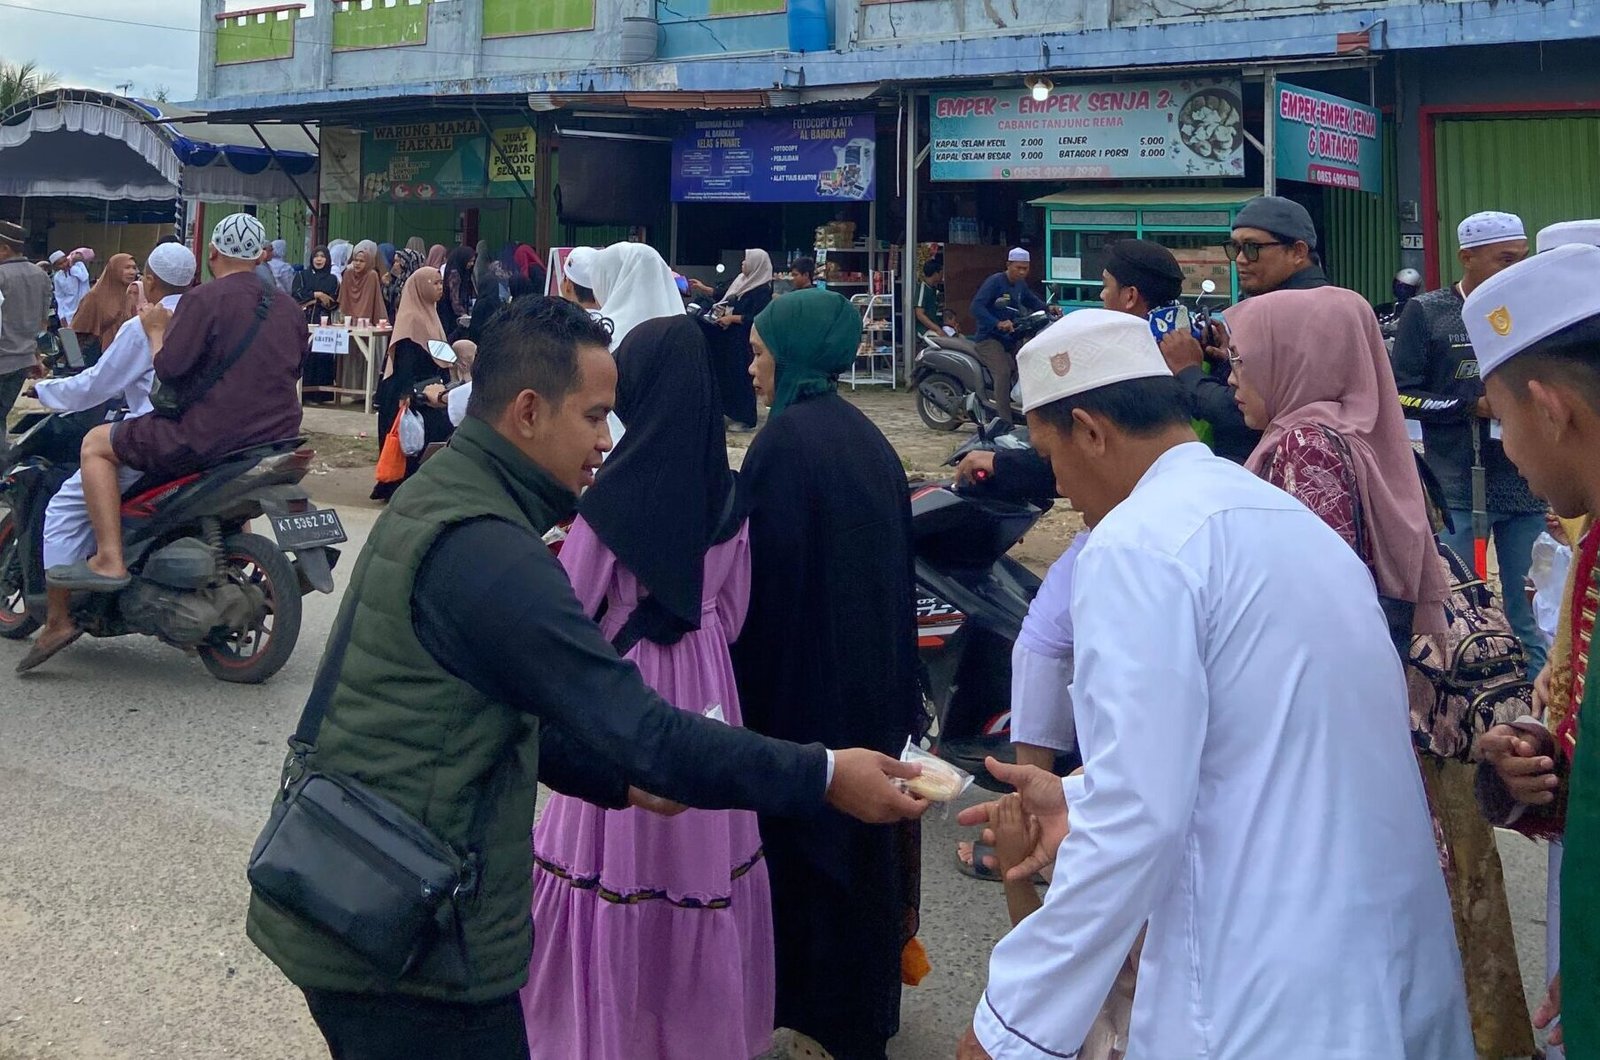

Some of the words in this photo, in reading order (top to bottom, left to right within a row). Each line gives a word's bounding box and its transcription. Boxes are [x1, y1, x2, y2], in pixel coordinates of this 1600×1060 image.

[936, 97, 998, 118] EMPEK
[1018, 93, 1082, 115] EMPEK
[1087, 90, 1150, 112] SENJA
[1156, 89, 1170, 109] 2
[793, 118, 830, 129] FOTOCOPY
[839, 116, 854, 127] ATK
[998, 119, 1040, 130] CABANG
[1042, 118, 1090, 129] TANJUNG
[1093, 116, 1124, 127] REMA
[1352, 109, 1376, 140] SENJA
[375, 124, 431, 139] WARUNG
[435, 120, 478, 135] MAMA
[799, 130, 809, 140] AL
[398, 139, 452, 152] HAEKAL
[935, 139, 959, 148] KAPAL
[961, 138, 985, 148] SELAM
[986, 138, 1007, 148] KECIL
[1020, 138, 1044, 147] 2.000
[1058, 136, 1088, 145] LENJER
[1140, 136, 1165, 145] 5.000
[1309, 128, 1318, 156] &
[1319, 131, 1360, 164] BATAGOR
[494, 153, 535, 165] POTONG
[935, 152, 959, 161] KAPAL
[961, 152, 986, 161] SELAM
[987, 152, 1012, 161] BESAR
[1020, 151, 1044, 160] 9.000
[1058, 149, 1097, 159] BATAGOR
[1104, 148, 1129, 158] PORSI
[1140, 148, 1166, 157] 8.000
[496, 165, 531, 176] SEGAR
[278, 519, 292, 531] KT
[294, 516, 319, 529] 5362
